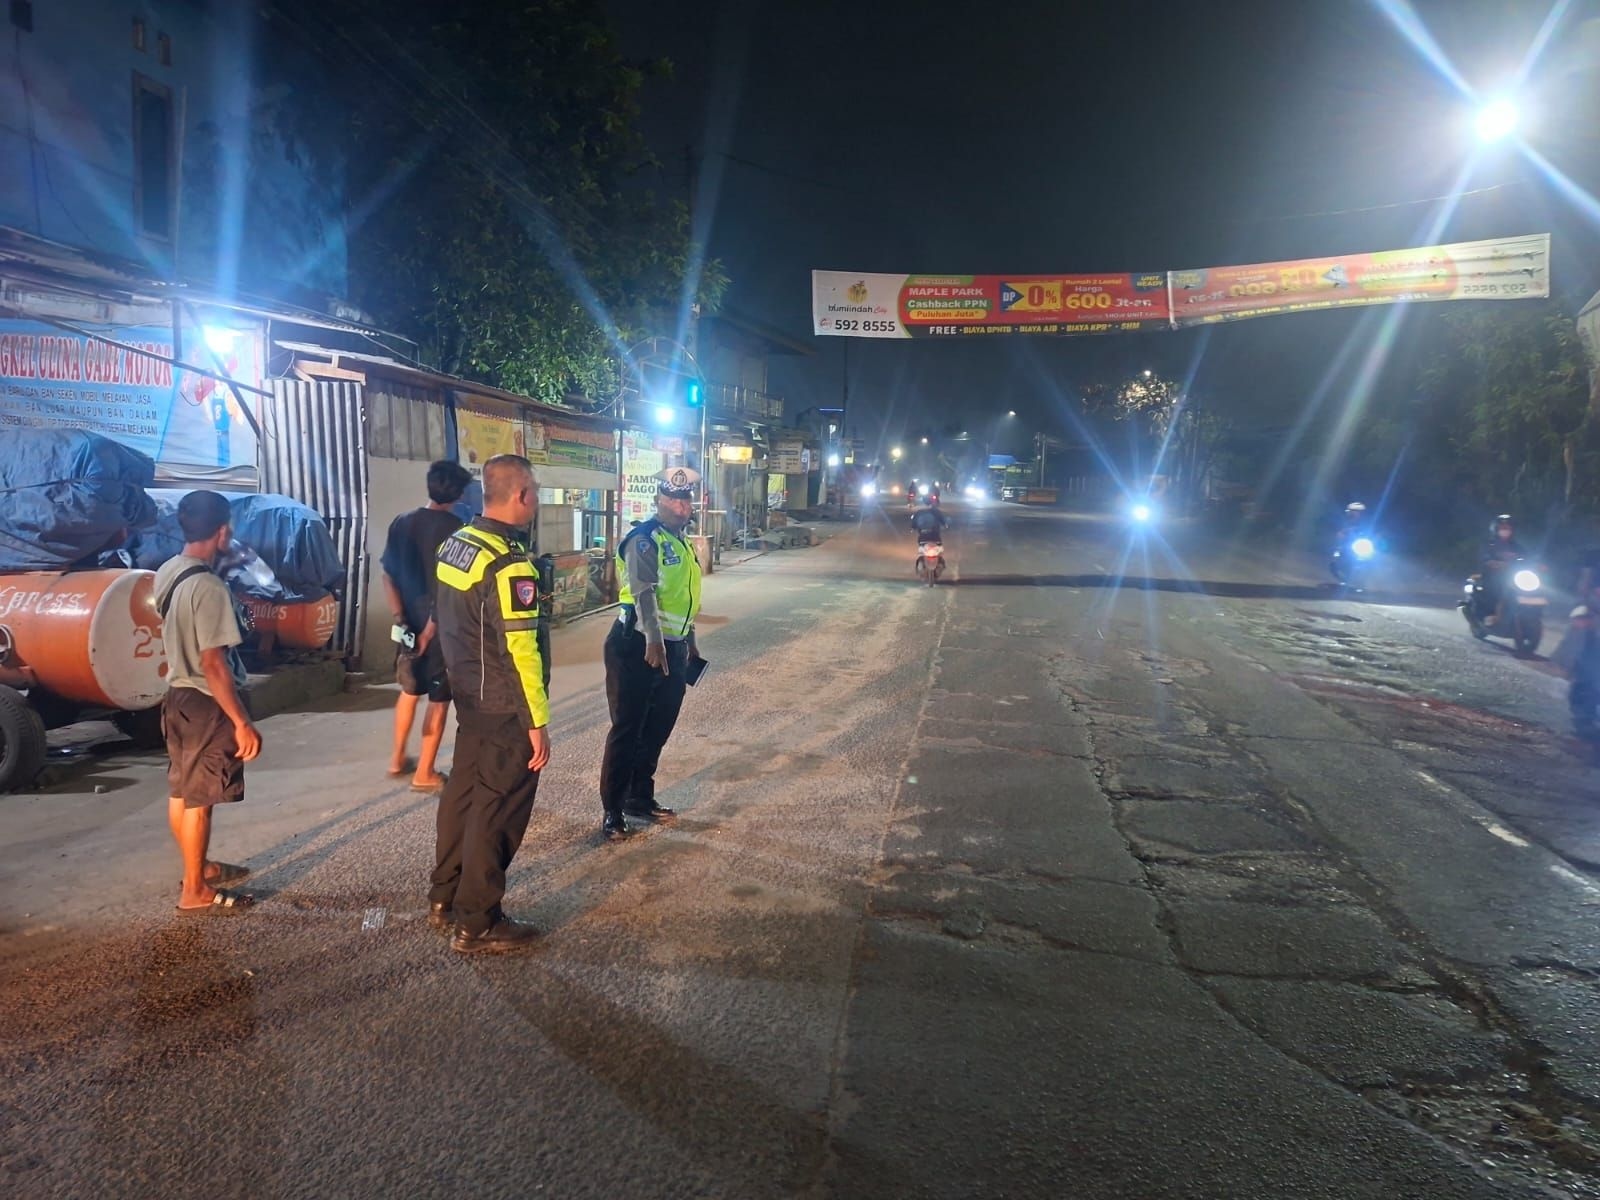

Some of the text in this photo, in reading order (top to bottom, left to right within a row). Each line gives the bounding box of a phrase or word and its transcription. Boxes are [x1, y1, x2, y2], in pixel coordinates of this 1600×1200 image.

[908, 287, 983, 296] MAPLE PARK
[1003, 291, 1016, 302] DP
[907, 299, 988, 309] Cashback PPN
[1065, 292, 1112, 310] 600
[916, 310, 952, 318] Puluhan
[834, 319, 859, 331] 592
[862, 320, 896, 332] 8555
[929, 326, 957, 335] FREE
[963, 326, 986, 335] BIAYA
[1019, 325, 1041, 333] BIAYA
[1066, 324, 1089, 333] BIAYA
[102, 392, 132, 404] MELAYANI
[135, 394, 152, 405] JASA
[69, 404, 104, 417] MAUPUN
[107, 406, 123, 418] BAN
[129, 408, 158, 420] DALAM
[127, 424, 158, 435] MELAYANI
[627, 474, 657, 484] JAMU
[628, 484, 655, 494] JAGO
[438, 537, 478, 571] POLISI
